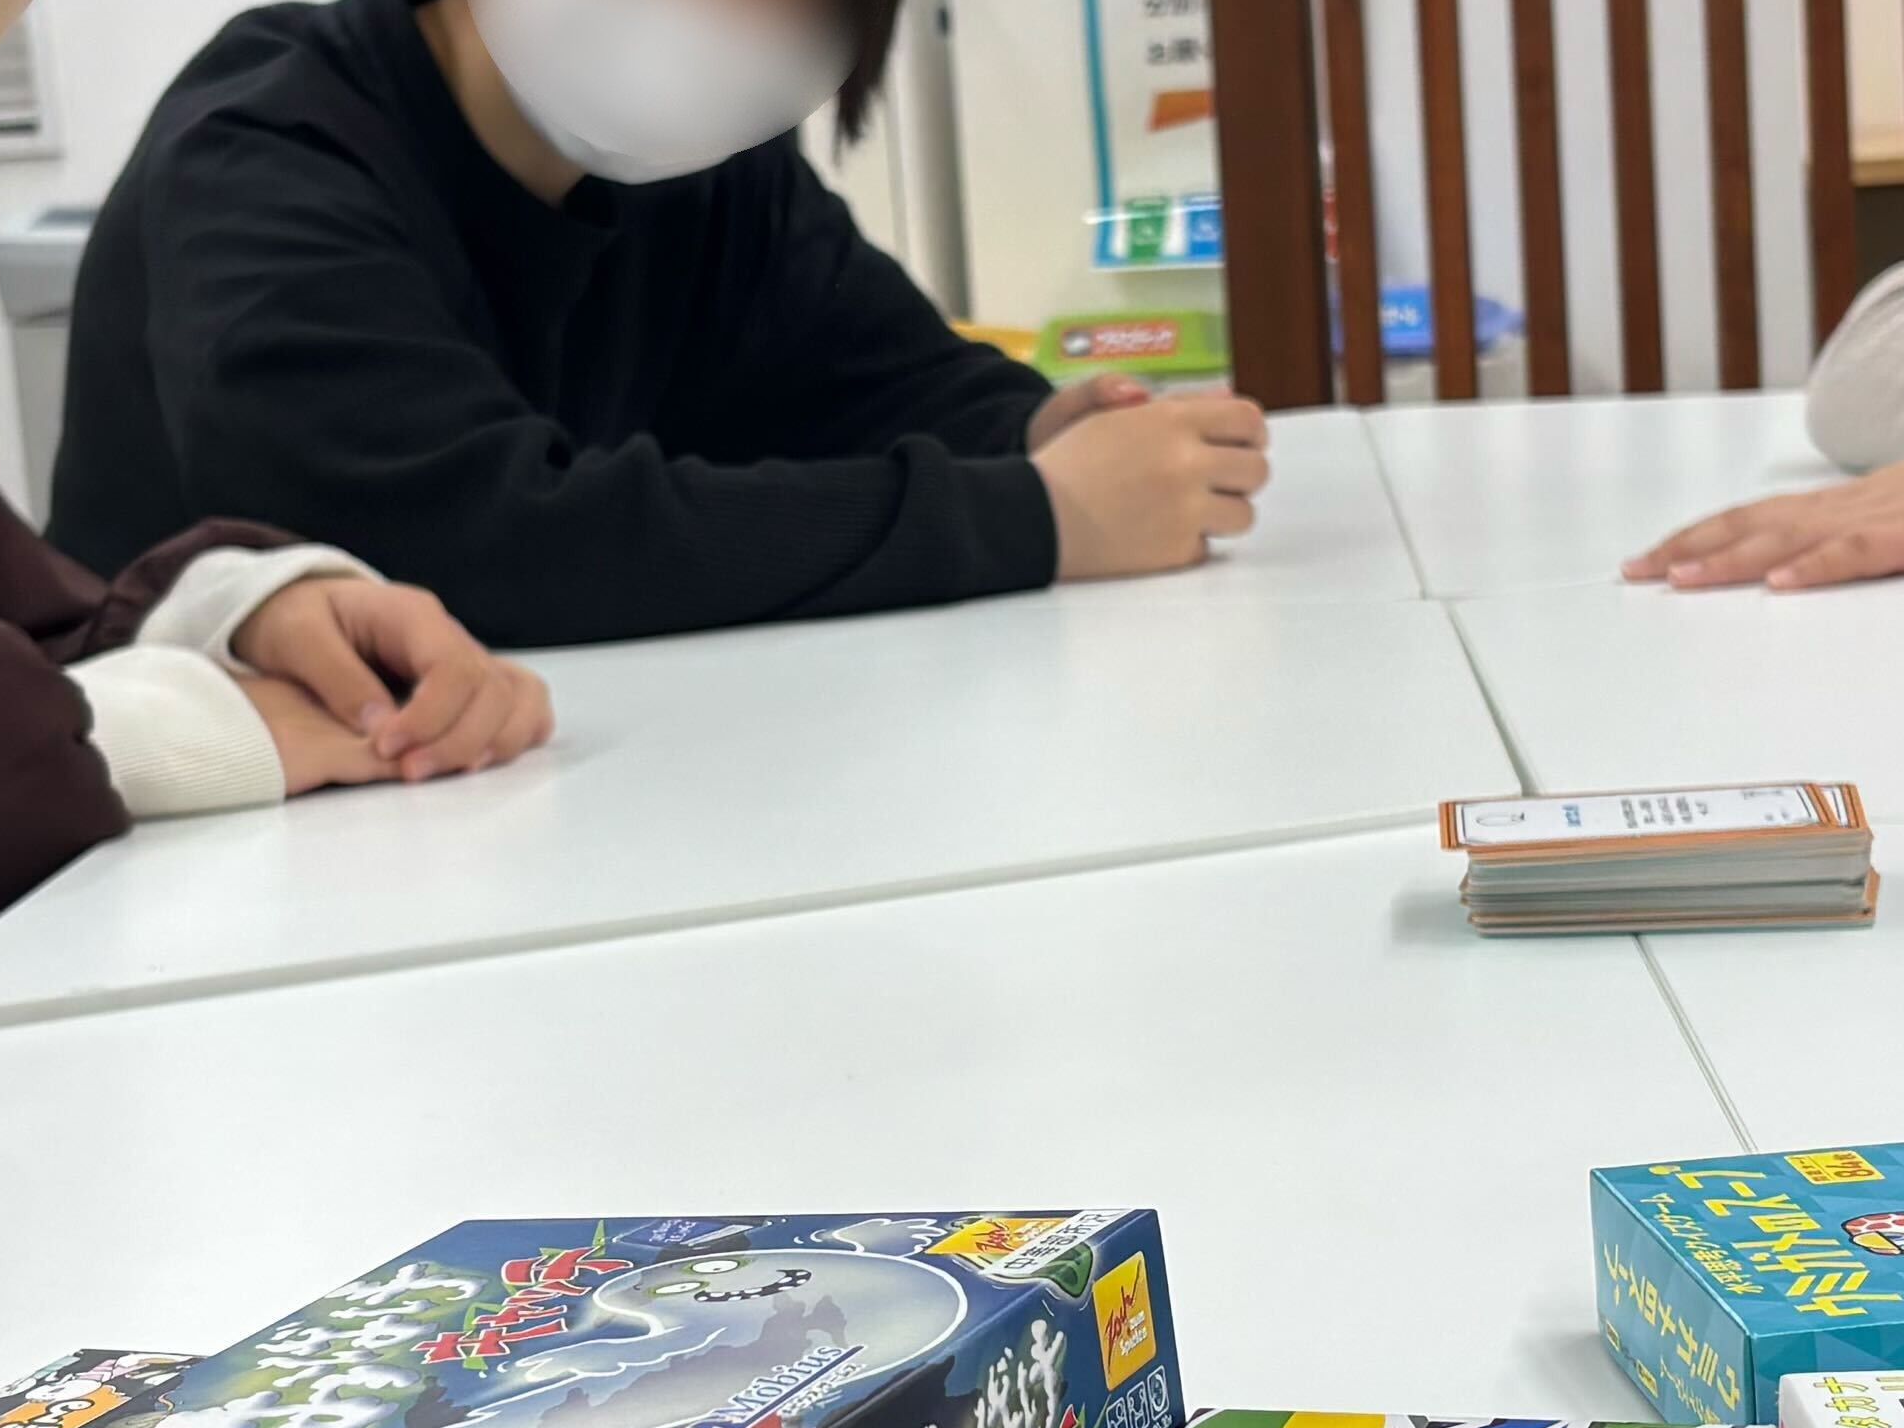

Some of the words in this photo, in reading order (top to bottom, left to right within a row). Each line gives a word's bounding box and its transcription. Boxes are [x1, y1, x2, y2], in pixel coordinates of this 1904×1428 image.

[410, 1246, 634, 1364] キャッチ
[1649, 1165, 1903, 1317] ウミガメのスープ
[728, 1344, 846, 1424] Möbius
[1603, 1243, 1741, 1410] ウミガメのスープ
